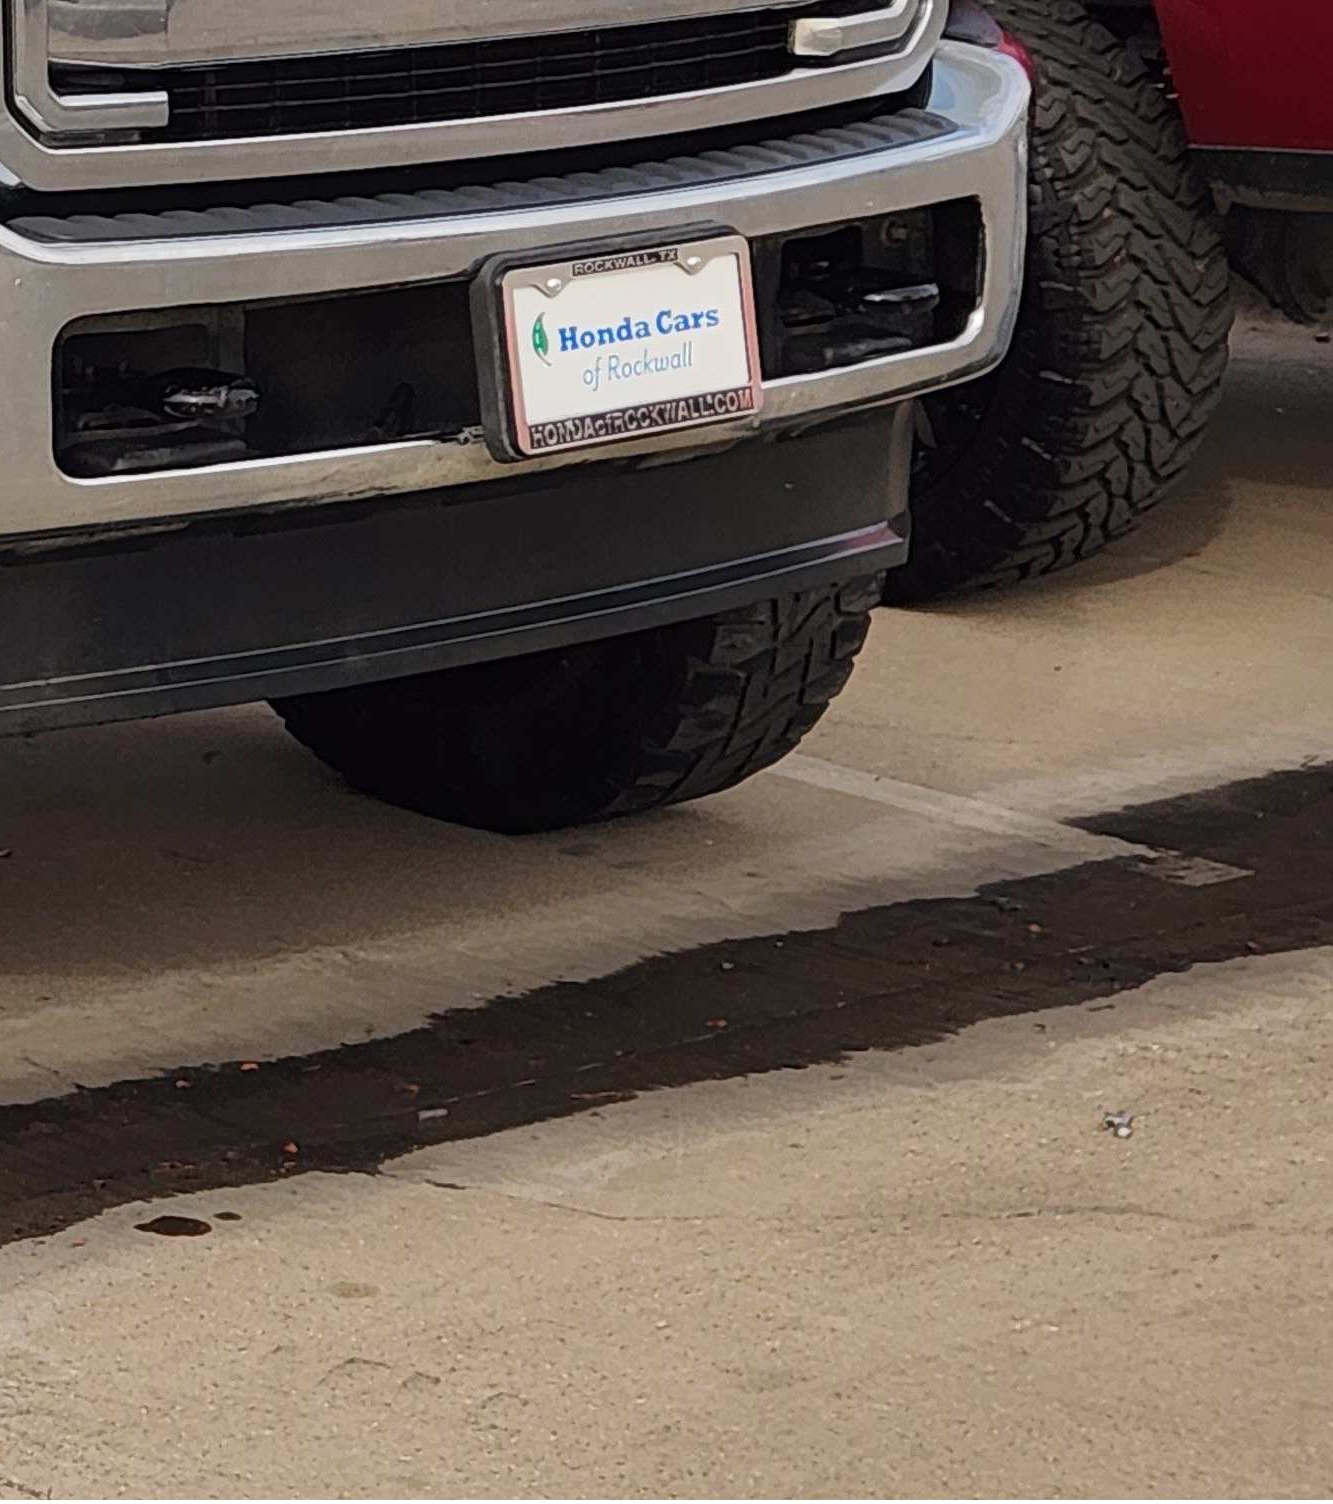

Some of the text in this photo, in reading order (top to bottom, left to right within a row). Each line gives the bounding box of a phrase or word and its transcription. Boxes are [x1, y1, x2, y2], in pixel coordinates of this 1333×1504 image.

[659, 250, 677, 261] TX
[558, 309, 720, 352] Honda Cars
[583, 341, 693, 391] of Rockwall
